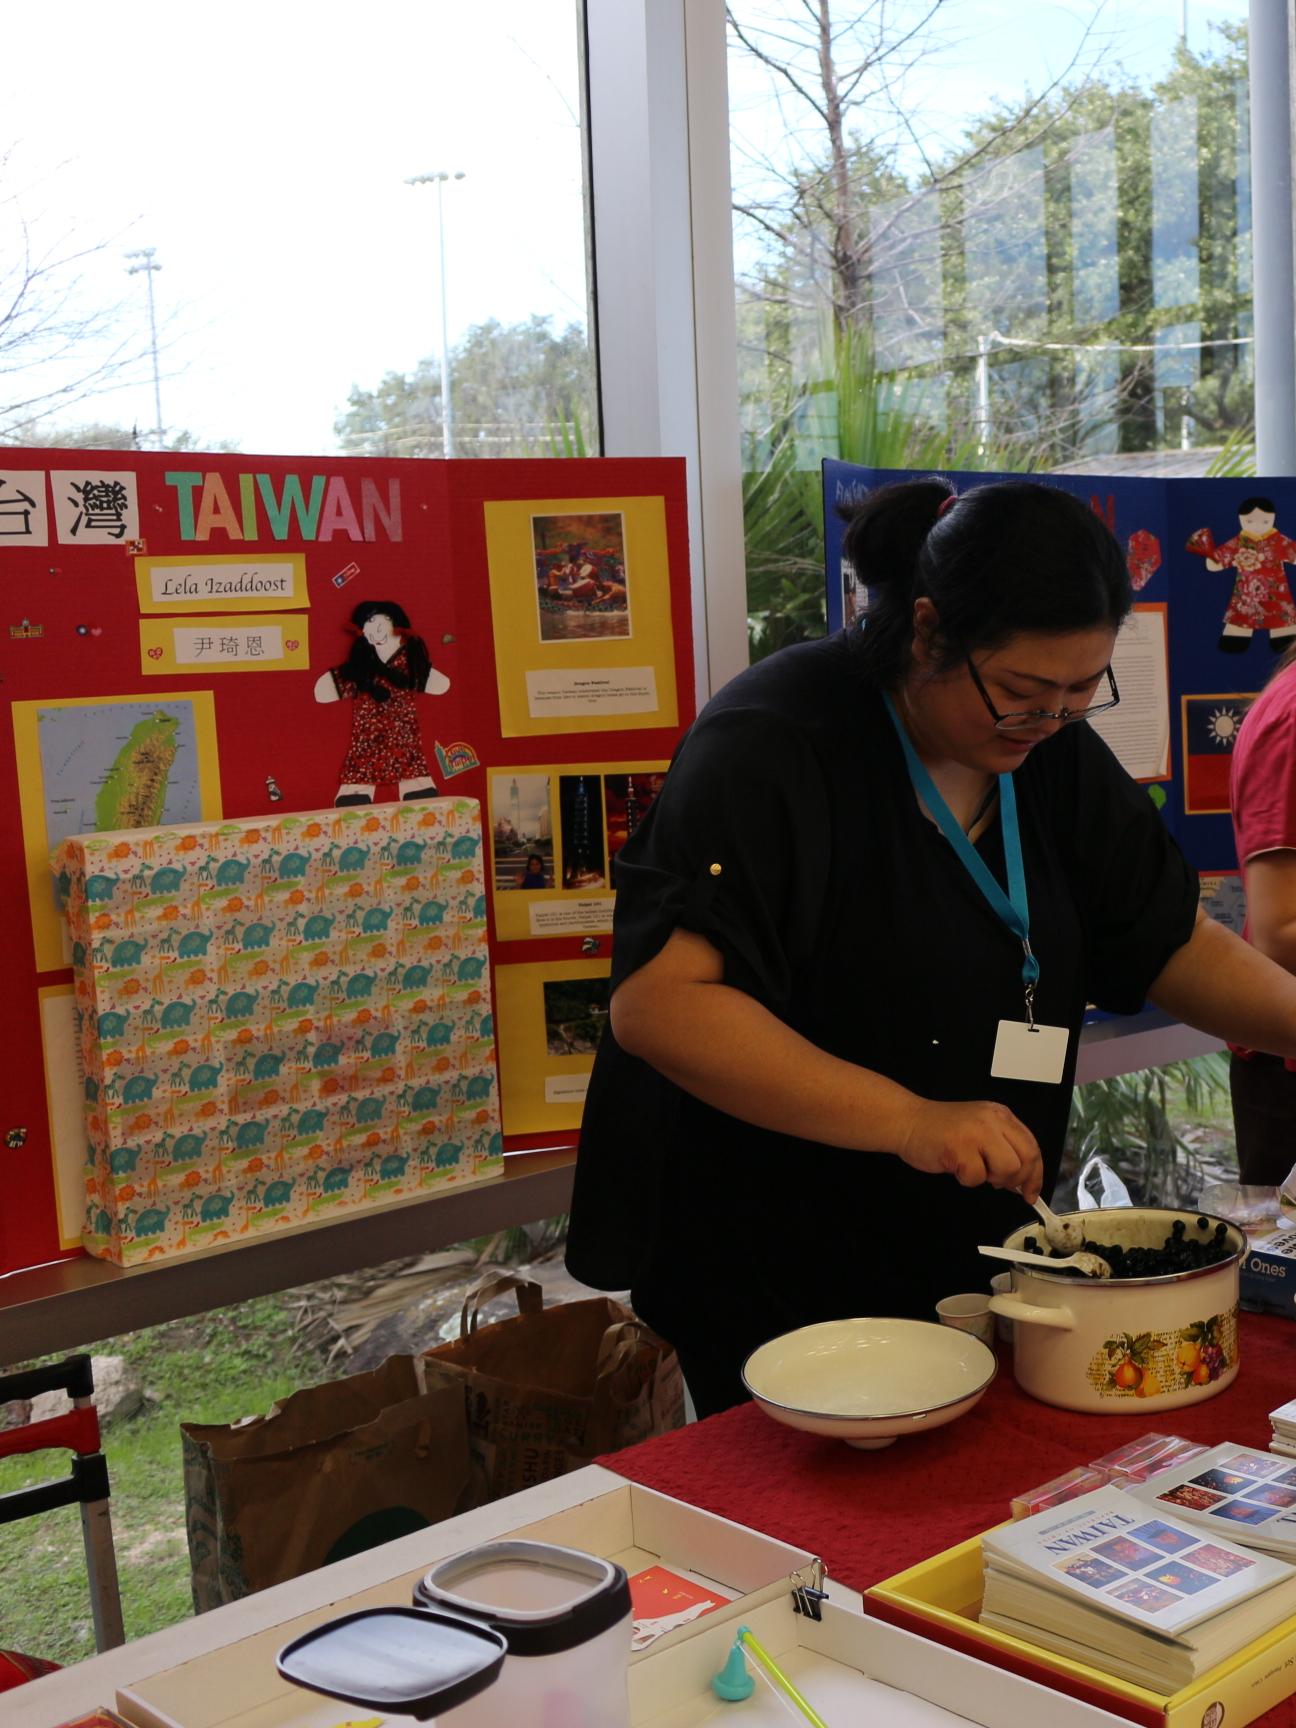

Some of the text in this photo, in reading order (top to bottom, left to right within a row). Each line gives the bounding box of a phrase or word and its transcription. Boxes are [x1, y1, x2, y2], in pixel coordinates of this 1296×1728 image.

[0, 478, 128, 540] 台灣
[165, 471, 402, 542] TAIWAN
[161, 572, 287, 596] Lela Izaddoost
[193, 634, 265, 658] 尹琦恩
[1250, 1257, 1286, 1278] Ones
[1044, 1514, 1135, 1555] TAIWAN
